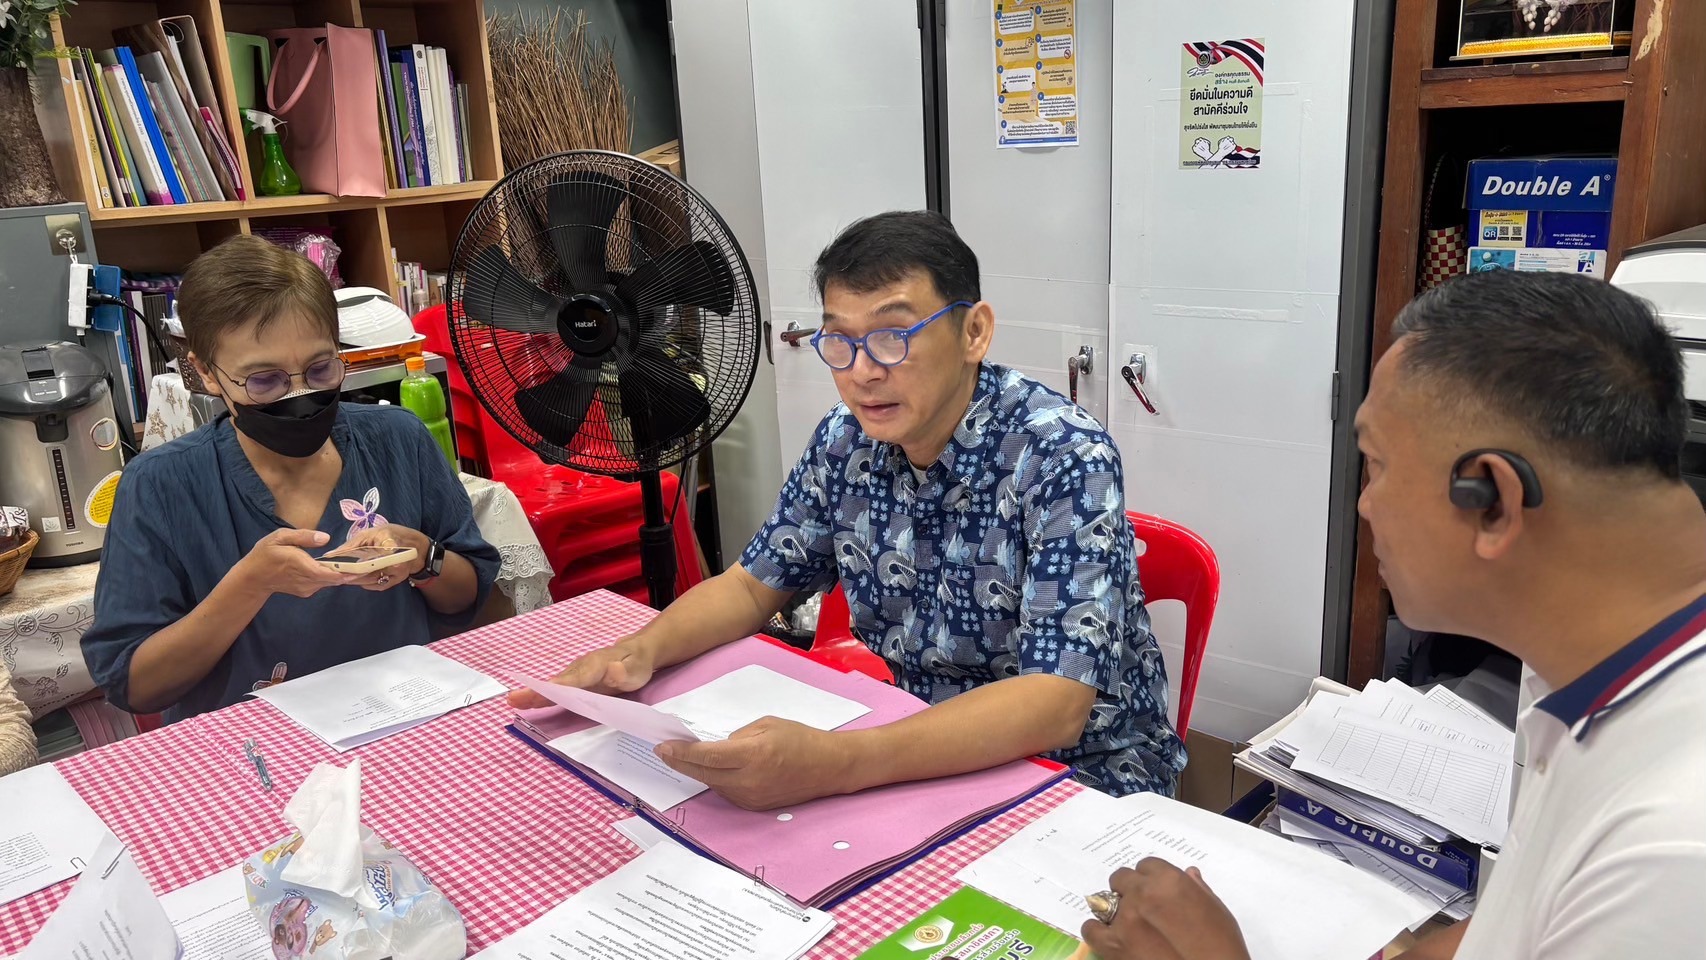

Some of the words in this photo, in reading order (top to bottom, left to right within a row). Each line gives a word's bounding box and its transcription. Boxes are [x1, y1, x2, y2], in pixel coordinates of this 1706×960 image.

[1215, 78, 1228, 86] สร้าง
[1190, 85, 1253, 101] ยึดมั่นในความดี
[1193, 102, 1249, 116] สามัคคีร่วมใจ
[1482, 175, 1573, 196] Double
[1484, 230, 1497, 238] QR
[574, 319, 597, 328] Hatari
[1334, 814, 1438, 870] Double
